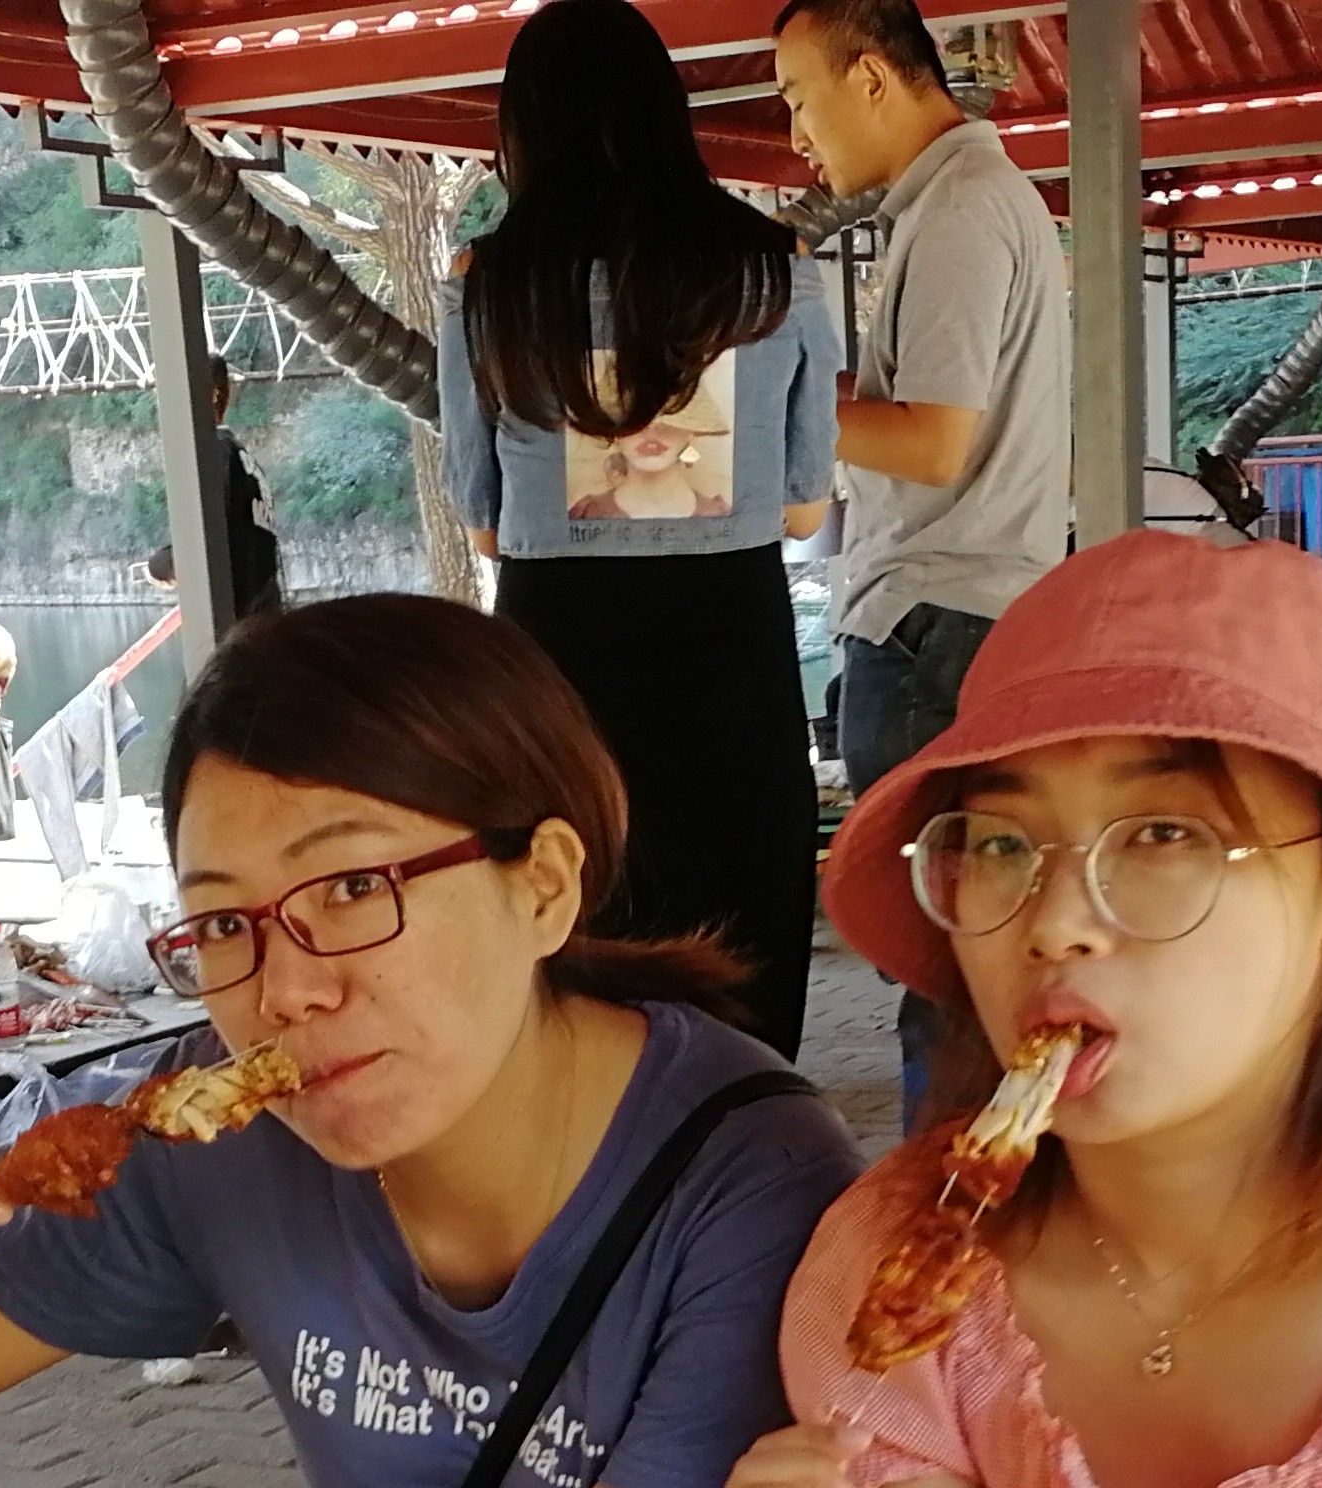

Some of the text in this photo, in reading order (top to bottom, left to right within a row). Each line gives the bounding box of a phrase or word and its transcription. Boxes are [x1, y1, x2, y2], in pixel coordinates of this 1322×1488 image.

[294, 1328, 347, 1379] It's
[356, 1346, 411, 1396] Not
[291, 1365, 337, 1416] It's
[353, 1385, 434, 1436] What
